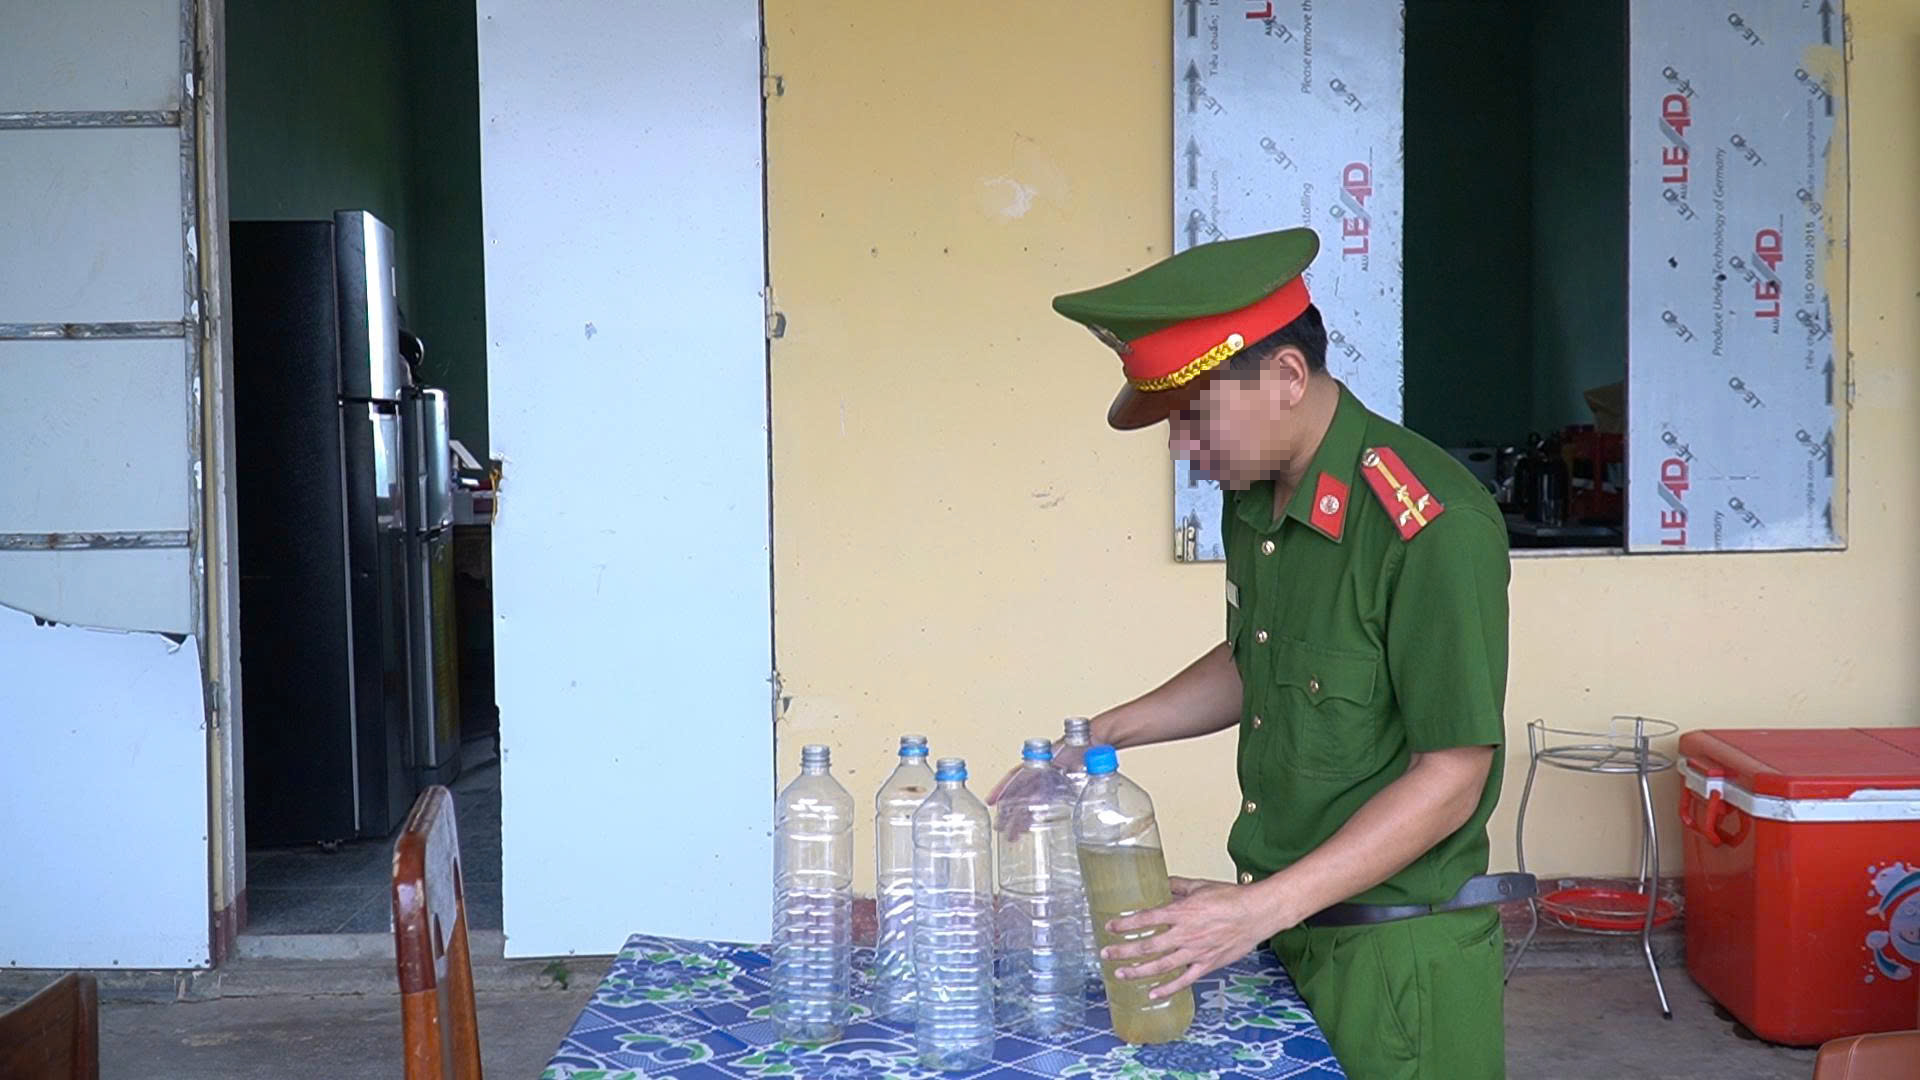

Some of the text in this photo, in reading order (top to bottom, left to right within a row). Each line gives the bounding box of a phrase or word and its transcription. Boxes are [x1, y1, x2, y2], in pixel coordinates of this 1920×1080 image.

[1300, 0, 1312, 94] Please remove th
[1729, 13, 1762, 46] LEAD
[1660, 94, 1691, 183] LEAD
[1730, 134, 1763, 167] LEAD
[1713, 147, 1727, 198] Germany
[1340, 162, 1372, 255] LEAD
[1713, 199, 1724, 211] of
[1712, 215, 1726, 273] Technology
[1752, 229, 1783, 318] LEAD
[1804, 282, 1815, 304] ISO
[1661, 310, 1694, 342] LEAD
[1712, 313, 1723, 356] Produce
[1728, 377, 1761, 409] LEAD
[1658, 458, 1690, 545] LEAD
[1728, 497, 1761, 529] LEAD
[1713, 511, 1725, 548] rmany
